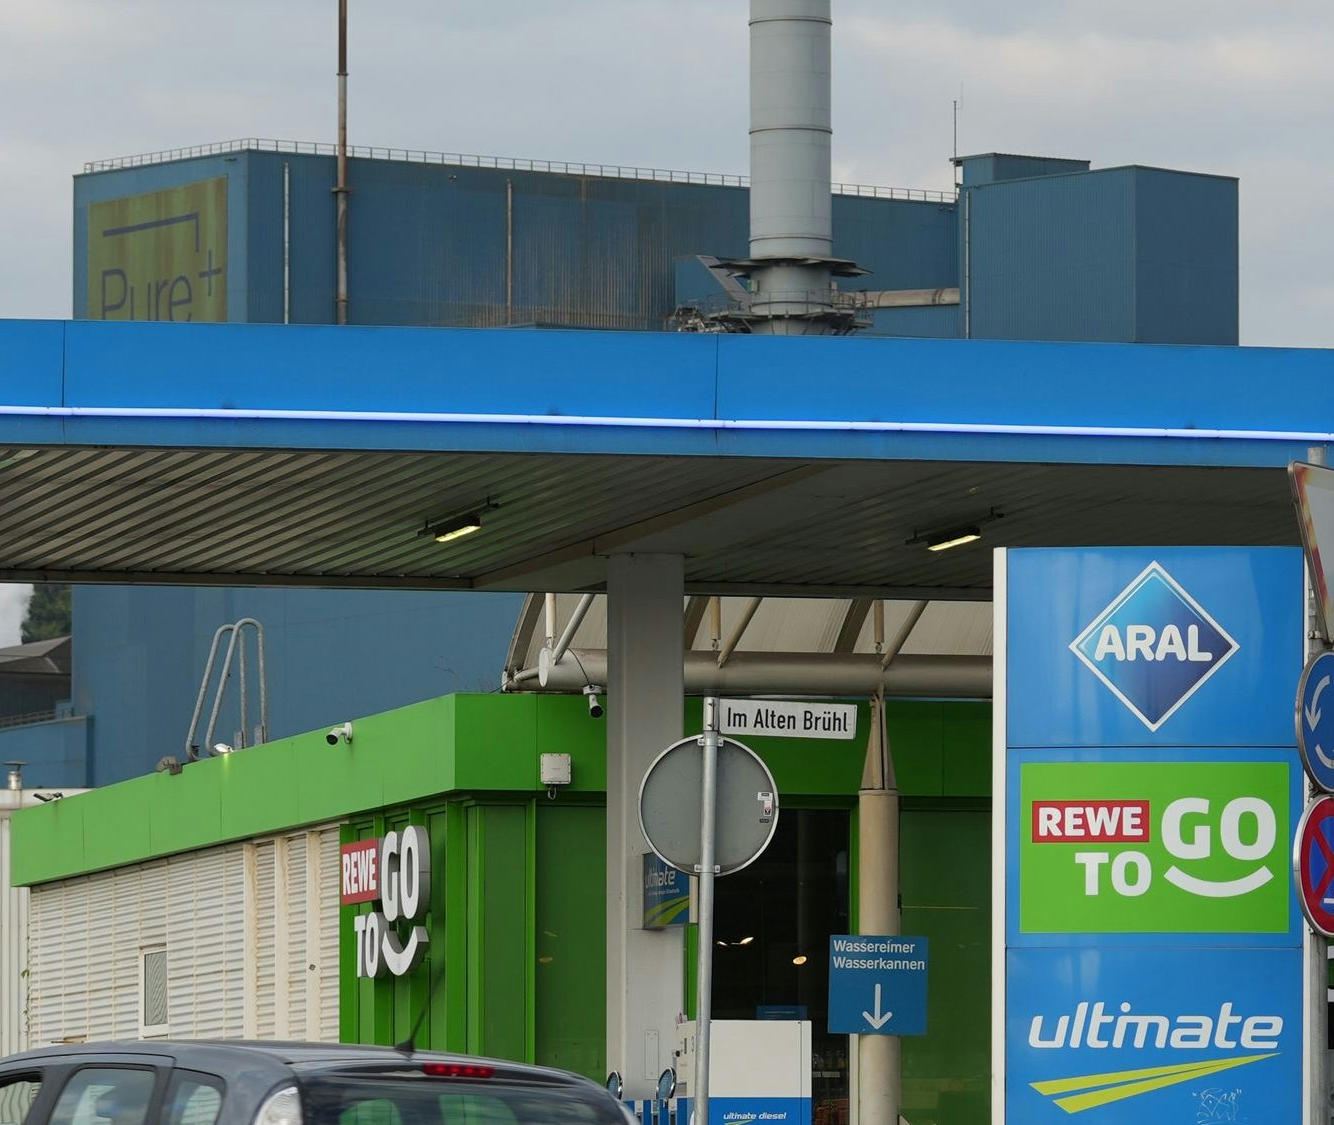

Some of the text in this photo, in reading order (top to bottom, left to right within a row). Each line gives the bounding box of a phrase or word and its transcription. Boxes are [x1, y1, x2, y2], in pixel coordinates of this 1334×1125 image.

[1094, 624, 1213, 662] ARAL
[727, 707, 848, 732] Im Alten Brühl
[1038, 806, 1144, 837] REWE
[1075, 797, 1277, 897] TO GO
[342, 848, 377, 896] REWE
[354, 825, 421, 979] TO GO
[833, 939, 916, 954] Wassereimer
[833, 956, 926, 971] Wasserkannen
[1028, 1001, 1284, 1049] ultimate
[723, 1112, 787, 1120] ultimate diesel
